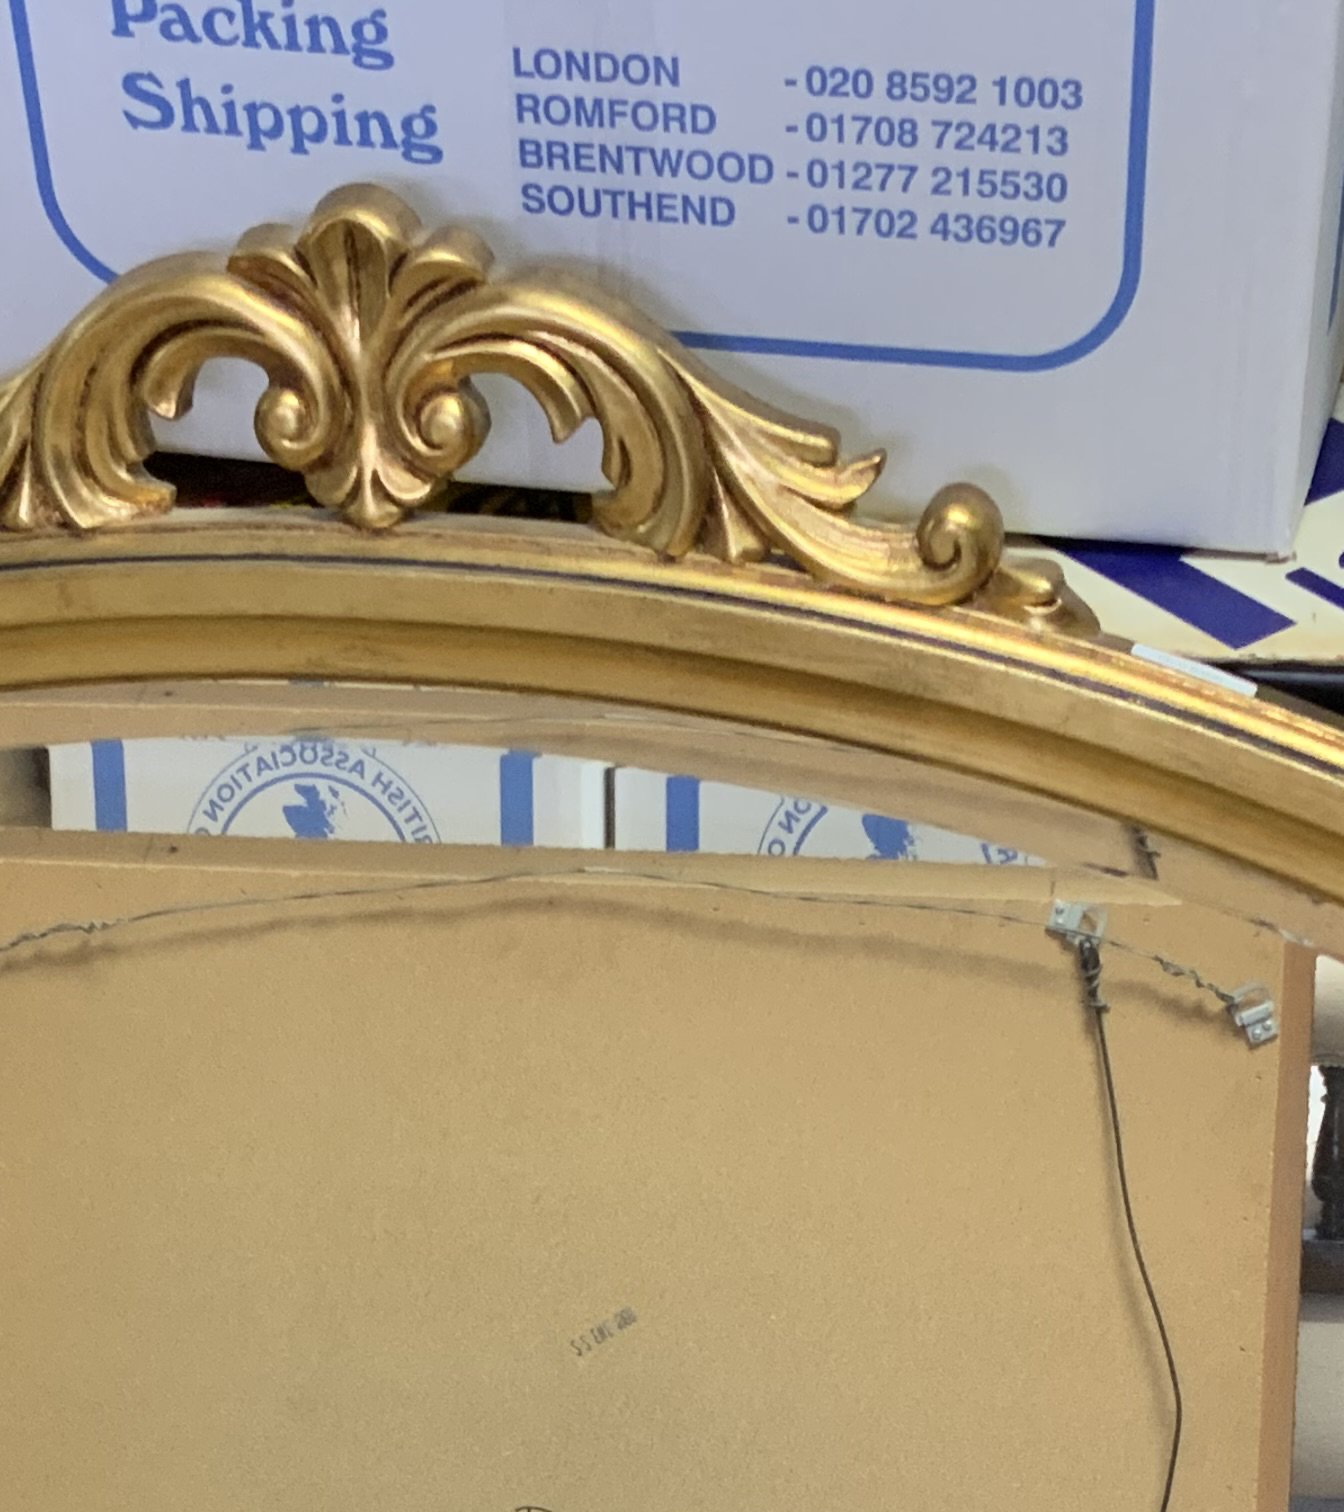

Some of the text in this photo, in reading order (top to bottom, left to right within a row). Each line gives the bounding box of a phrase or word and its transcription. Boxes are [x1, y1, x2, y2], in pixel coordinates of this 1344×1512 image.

[111, 0, 395, 71] Packing
[512, 46, 680, 87] LONDON
[886, 71, 978, 104] 8592
[992, 77, 1083, 110] 1003
[121, 70, 444, 164] Shipping
[516, 93, 717, 135] ROMFORD
[931, 119, 1069, 157] 724213
[519, 138, 774, 185] BRENTWOOD
[930, 165, 1068, 203] 215530
[522, 184, 736, 227] SOUTHEND
[930, 210, 1067, 248] 436967
